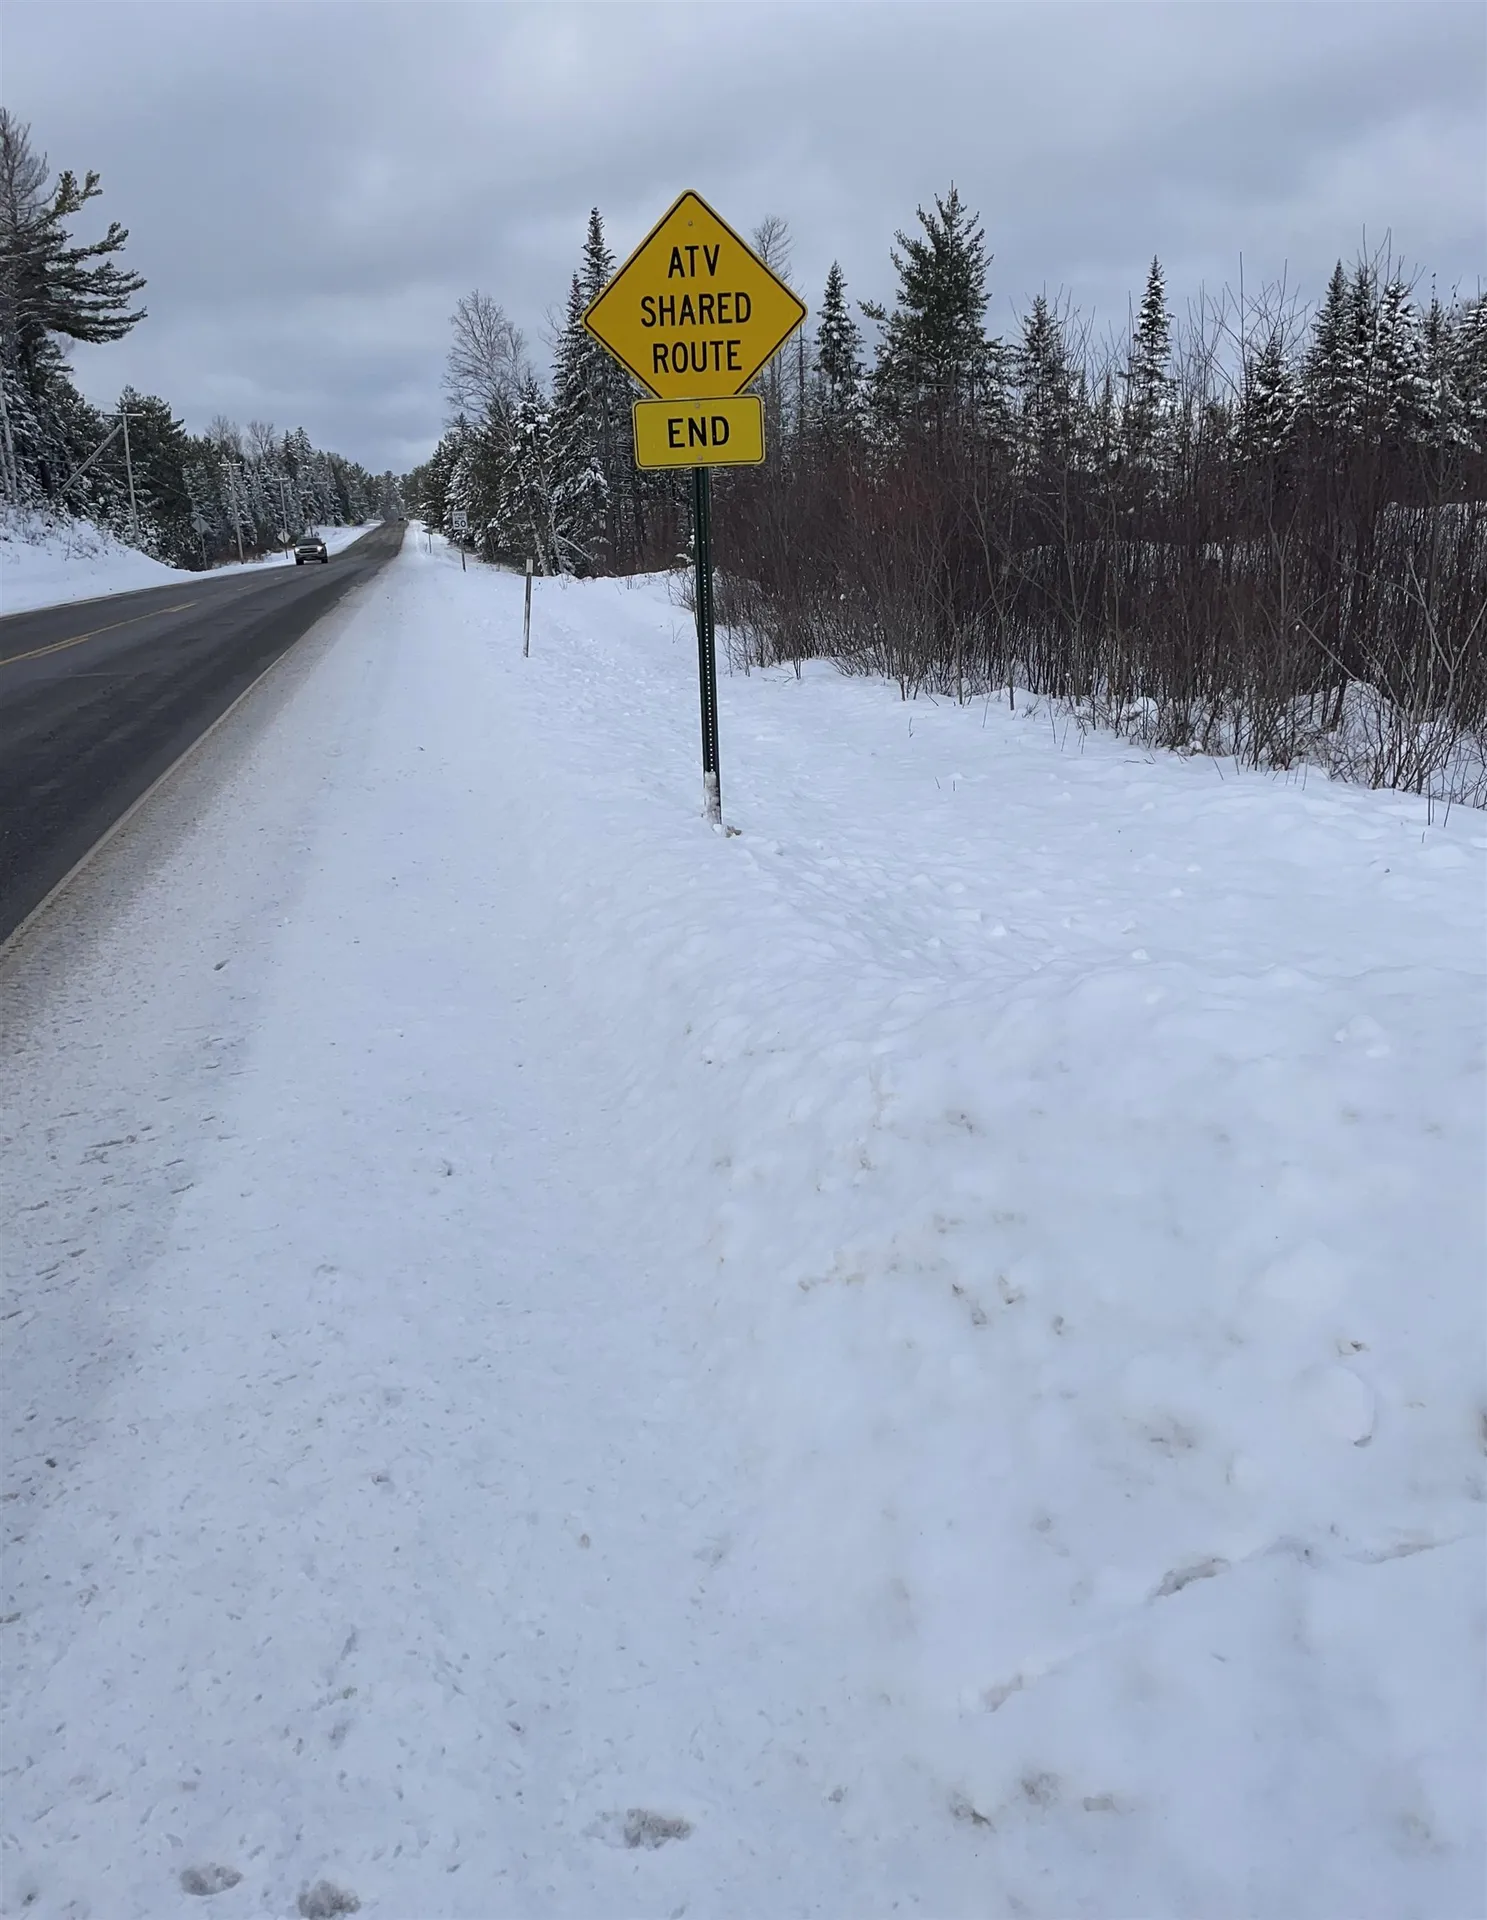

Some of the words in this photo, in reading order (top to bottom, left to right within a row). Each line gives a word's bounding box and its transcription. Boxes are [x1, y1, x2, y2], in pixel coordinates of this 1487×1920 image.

[667, 244, 720, 278] ATV
[640, 292, 752, 327] SHARED
[652, 340, 742, 374] ROUTE
[667, 416, 730, 448] END
[454, 520, 467, 528] 50
